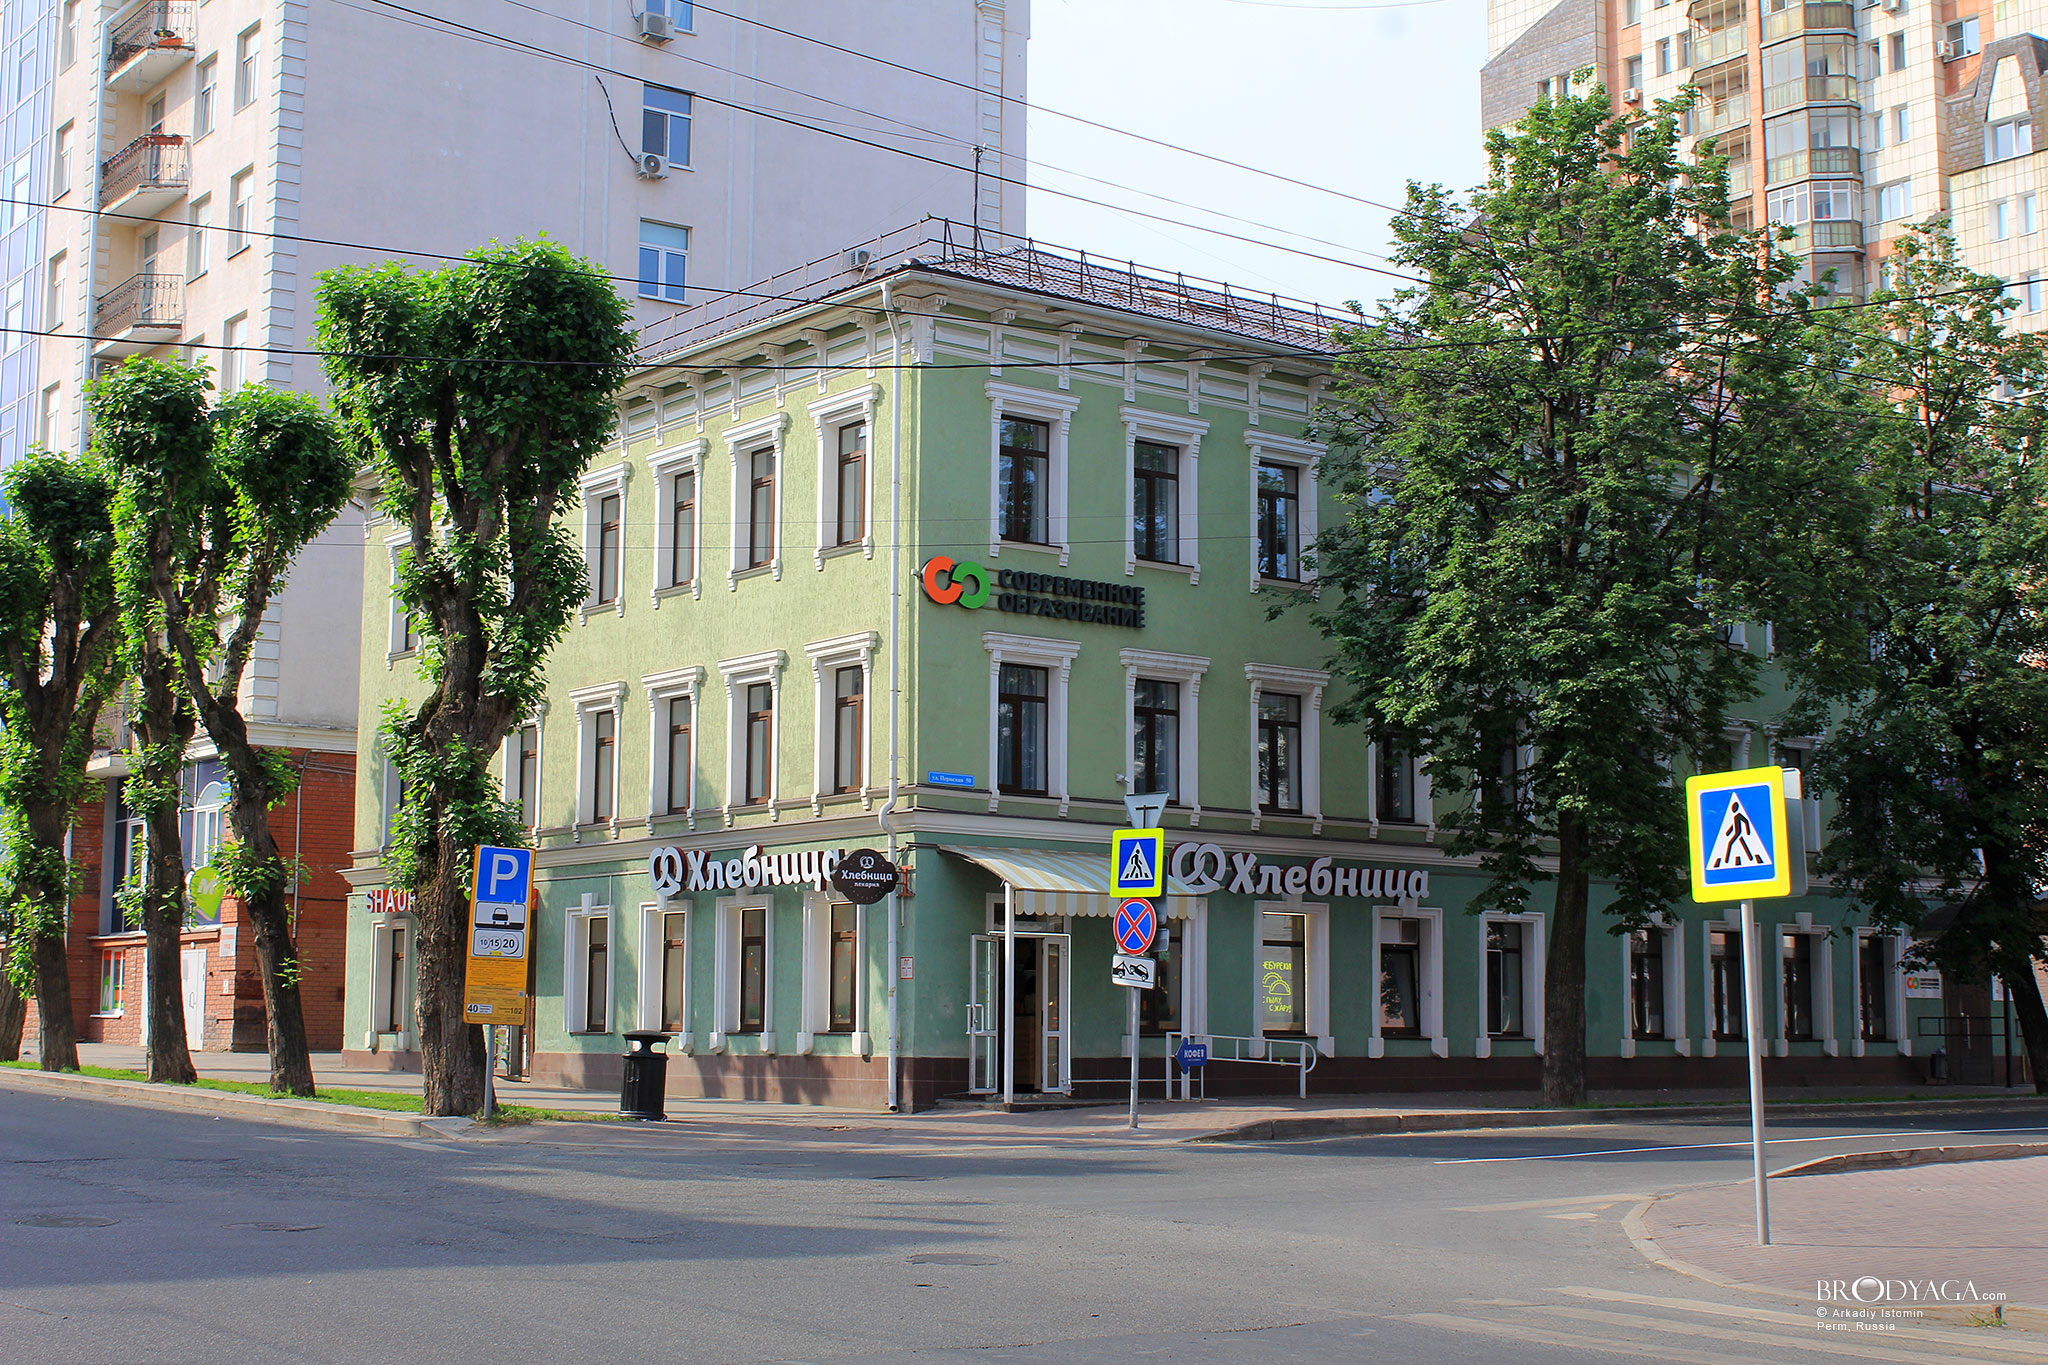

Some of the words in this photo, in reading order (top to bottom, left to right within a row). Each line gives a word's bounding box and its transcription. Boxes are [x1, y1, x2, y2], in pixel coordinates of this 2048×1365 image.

[998, 568, 1145, 606] СОВРЕМЕННОЕ
[998, 592, 1145, 628] ОБРАЗОВАНИЕ
[489, 853, 519, 895] P
[687, 844, 841, 892] Хлебница
[841, 869, 893, 882] Хлебница
[1228, 851, 1430, 907] Хлебница
[490, 939, 499, 947] 15
[503, 939, 515, 949] 20
[467, 1004, 479, 1013] 40
[510, 1007, 522, 1015] 102
